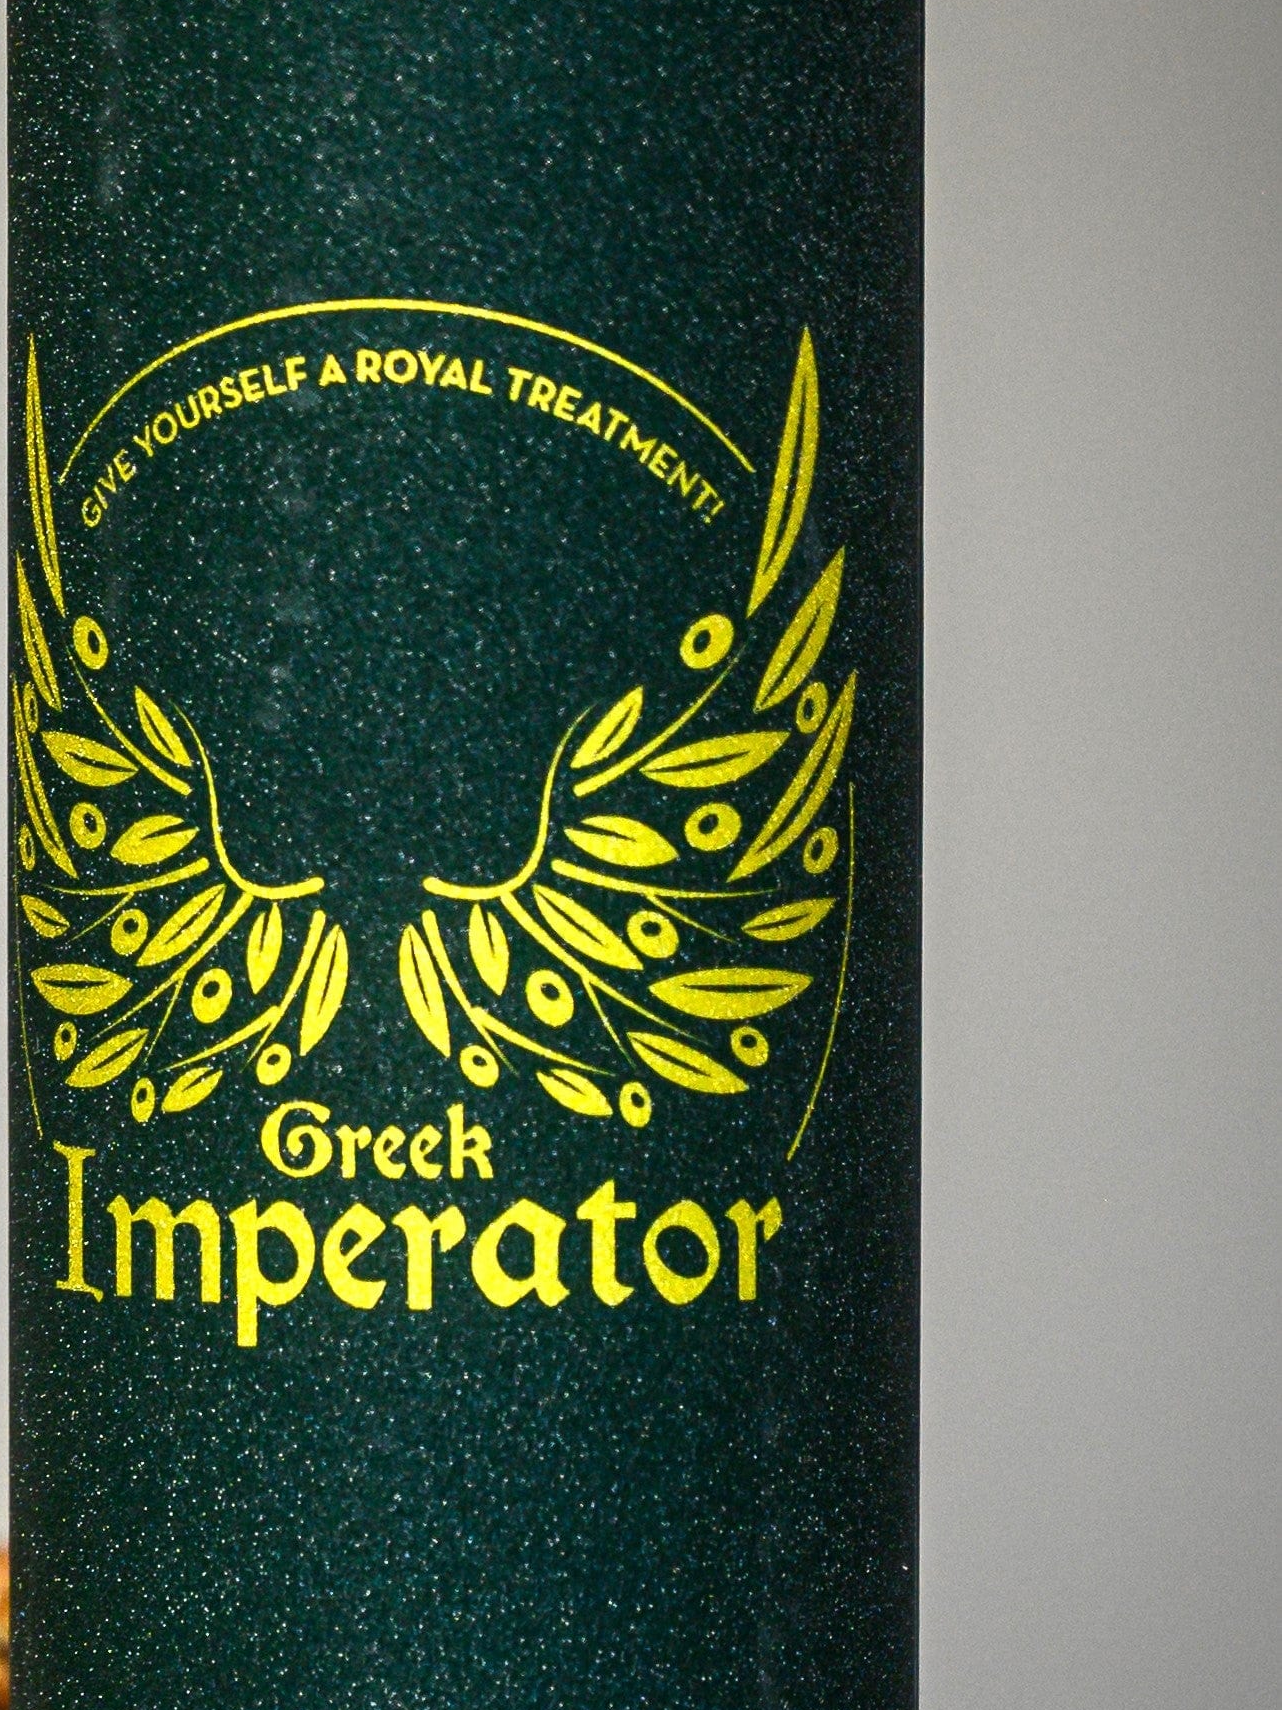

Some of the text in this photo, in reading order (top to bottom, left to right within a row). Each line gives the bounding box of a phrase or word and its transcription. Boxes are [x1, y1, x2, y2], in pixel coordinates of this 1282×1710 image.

[81, 347, 726, 528] GIVE YOURSELF A ROYAL TREATMENT!
[262, 1101, 495, 1180] Greek
[52, 1139, 784, 1349] Imperator
